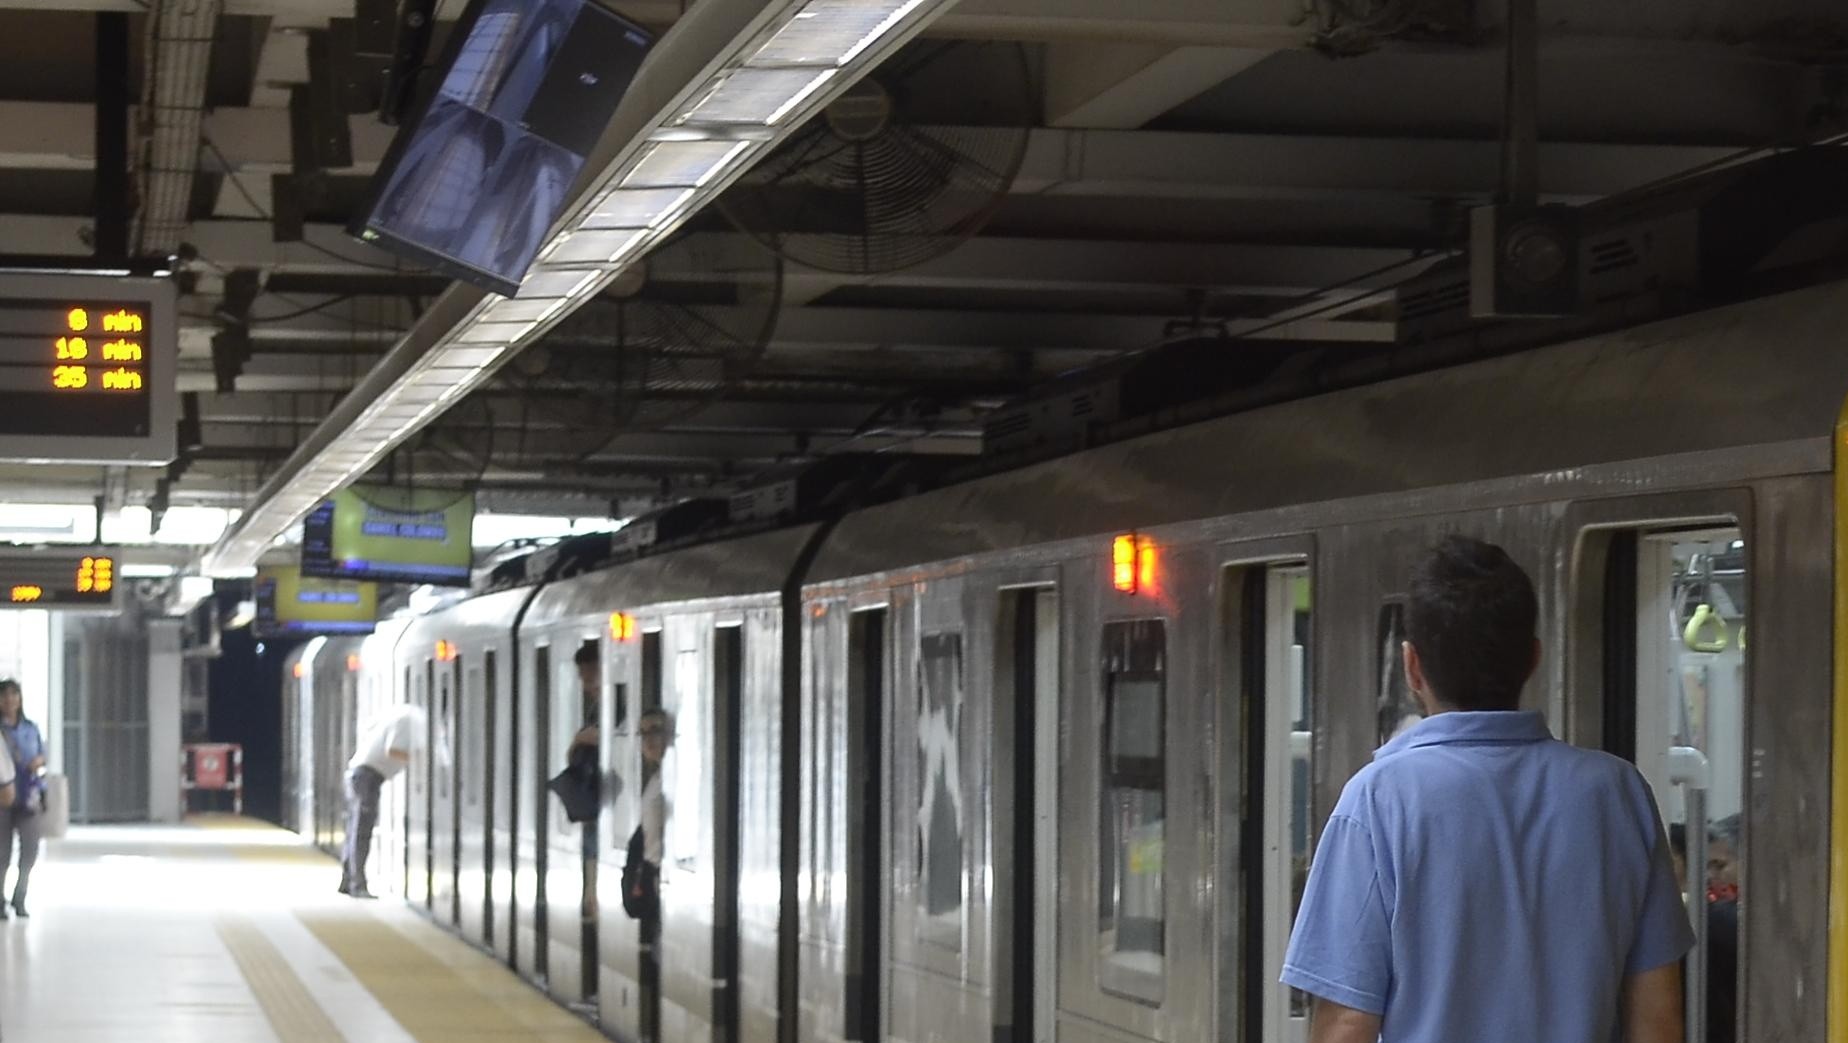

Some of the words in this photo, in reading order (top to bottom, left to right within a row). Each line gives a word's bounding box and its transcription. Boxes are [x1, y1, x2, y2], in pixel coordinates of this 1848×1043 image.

[103, 309, 142, 332] min
[102, 338, 142, 360] min
[102, 367, 142, 389] min
